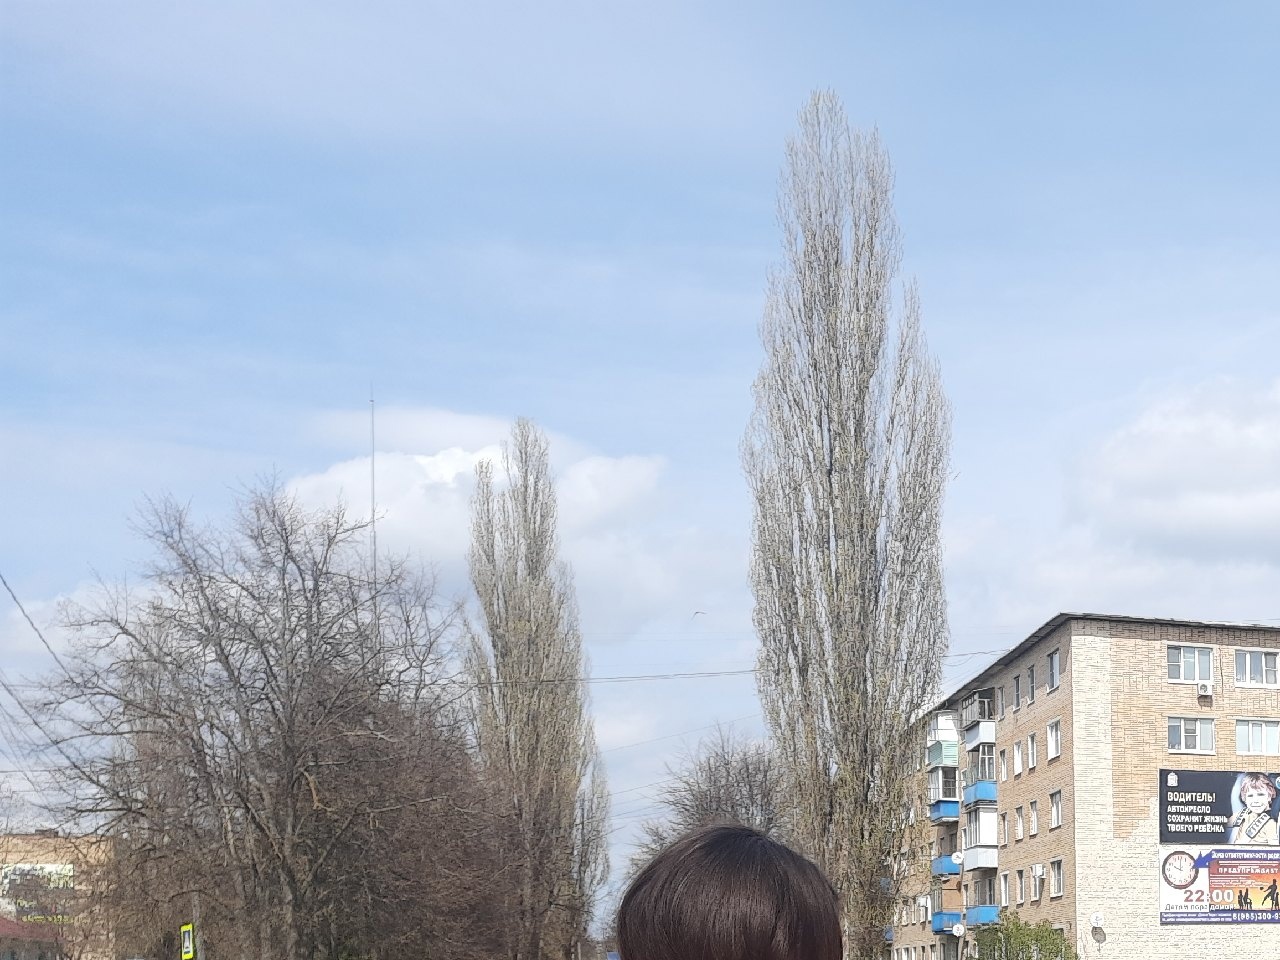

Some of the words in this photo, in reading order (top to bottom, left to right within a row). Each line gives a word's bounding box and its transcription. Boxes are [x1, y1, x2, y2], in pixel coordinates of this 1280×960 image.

[1167, 791, 1216, 803] ВОДИТЕЛЬ!
[1167, 805, 1211, 814] АВТОКРЕСЛО
[1167, 814, 1203, 823] СОХРАНИТ
[1167, 823, 1193, 832] ТВОЕГО
[1183, 889, 1234, 903] 22:00
